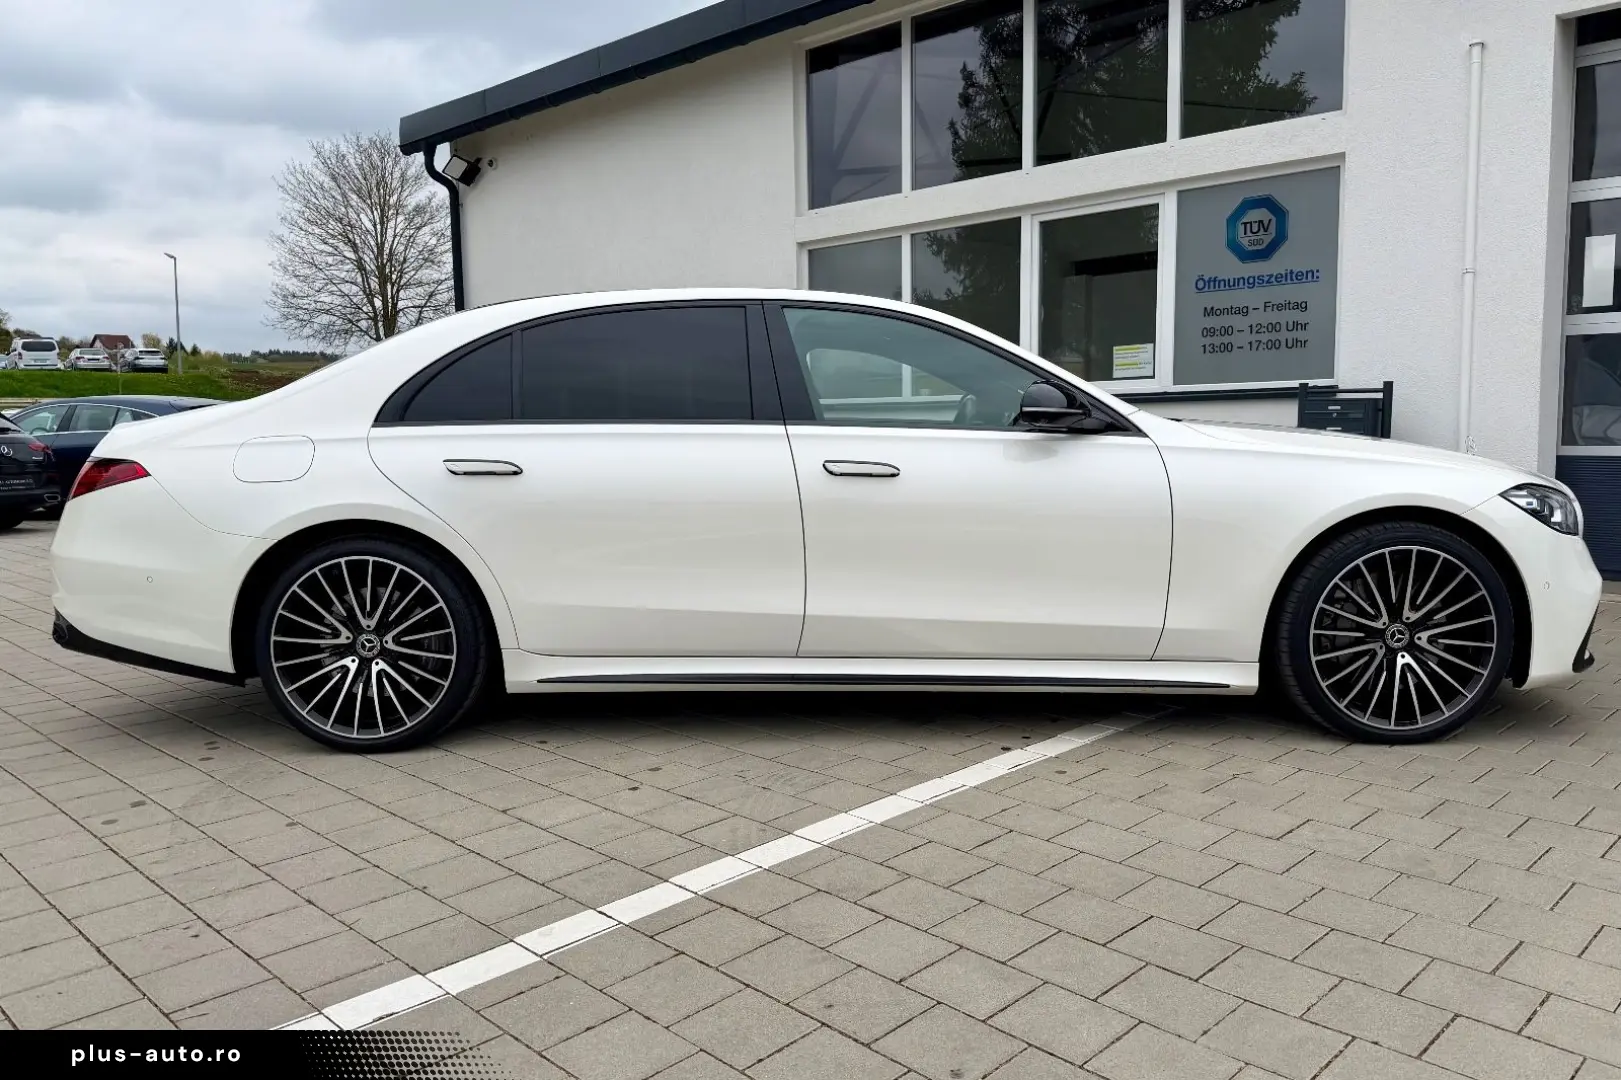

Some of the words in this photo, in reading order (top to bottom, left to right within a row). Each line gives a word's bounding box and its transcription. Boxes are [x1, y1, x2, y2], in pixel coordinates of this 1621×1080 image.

[1241, 218, 1272, 235] TÜV
[1195, 268, 1320, 290] Öffnungszeiten:
[1203, 304, 1249, 317] Montag
[1263, 300, 1308, 313] Freitag
[1201, 325, 1234, 338] 09:00
[1248, 321, 1282, 334] 12:00
[1285, 320, 1309, 332] Uhr
[1201, 342, 1233, 354] 13:00
[1247, 339, 1281, 351] 17:00
[1285, 337, 1309, 349] Uhr
